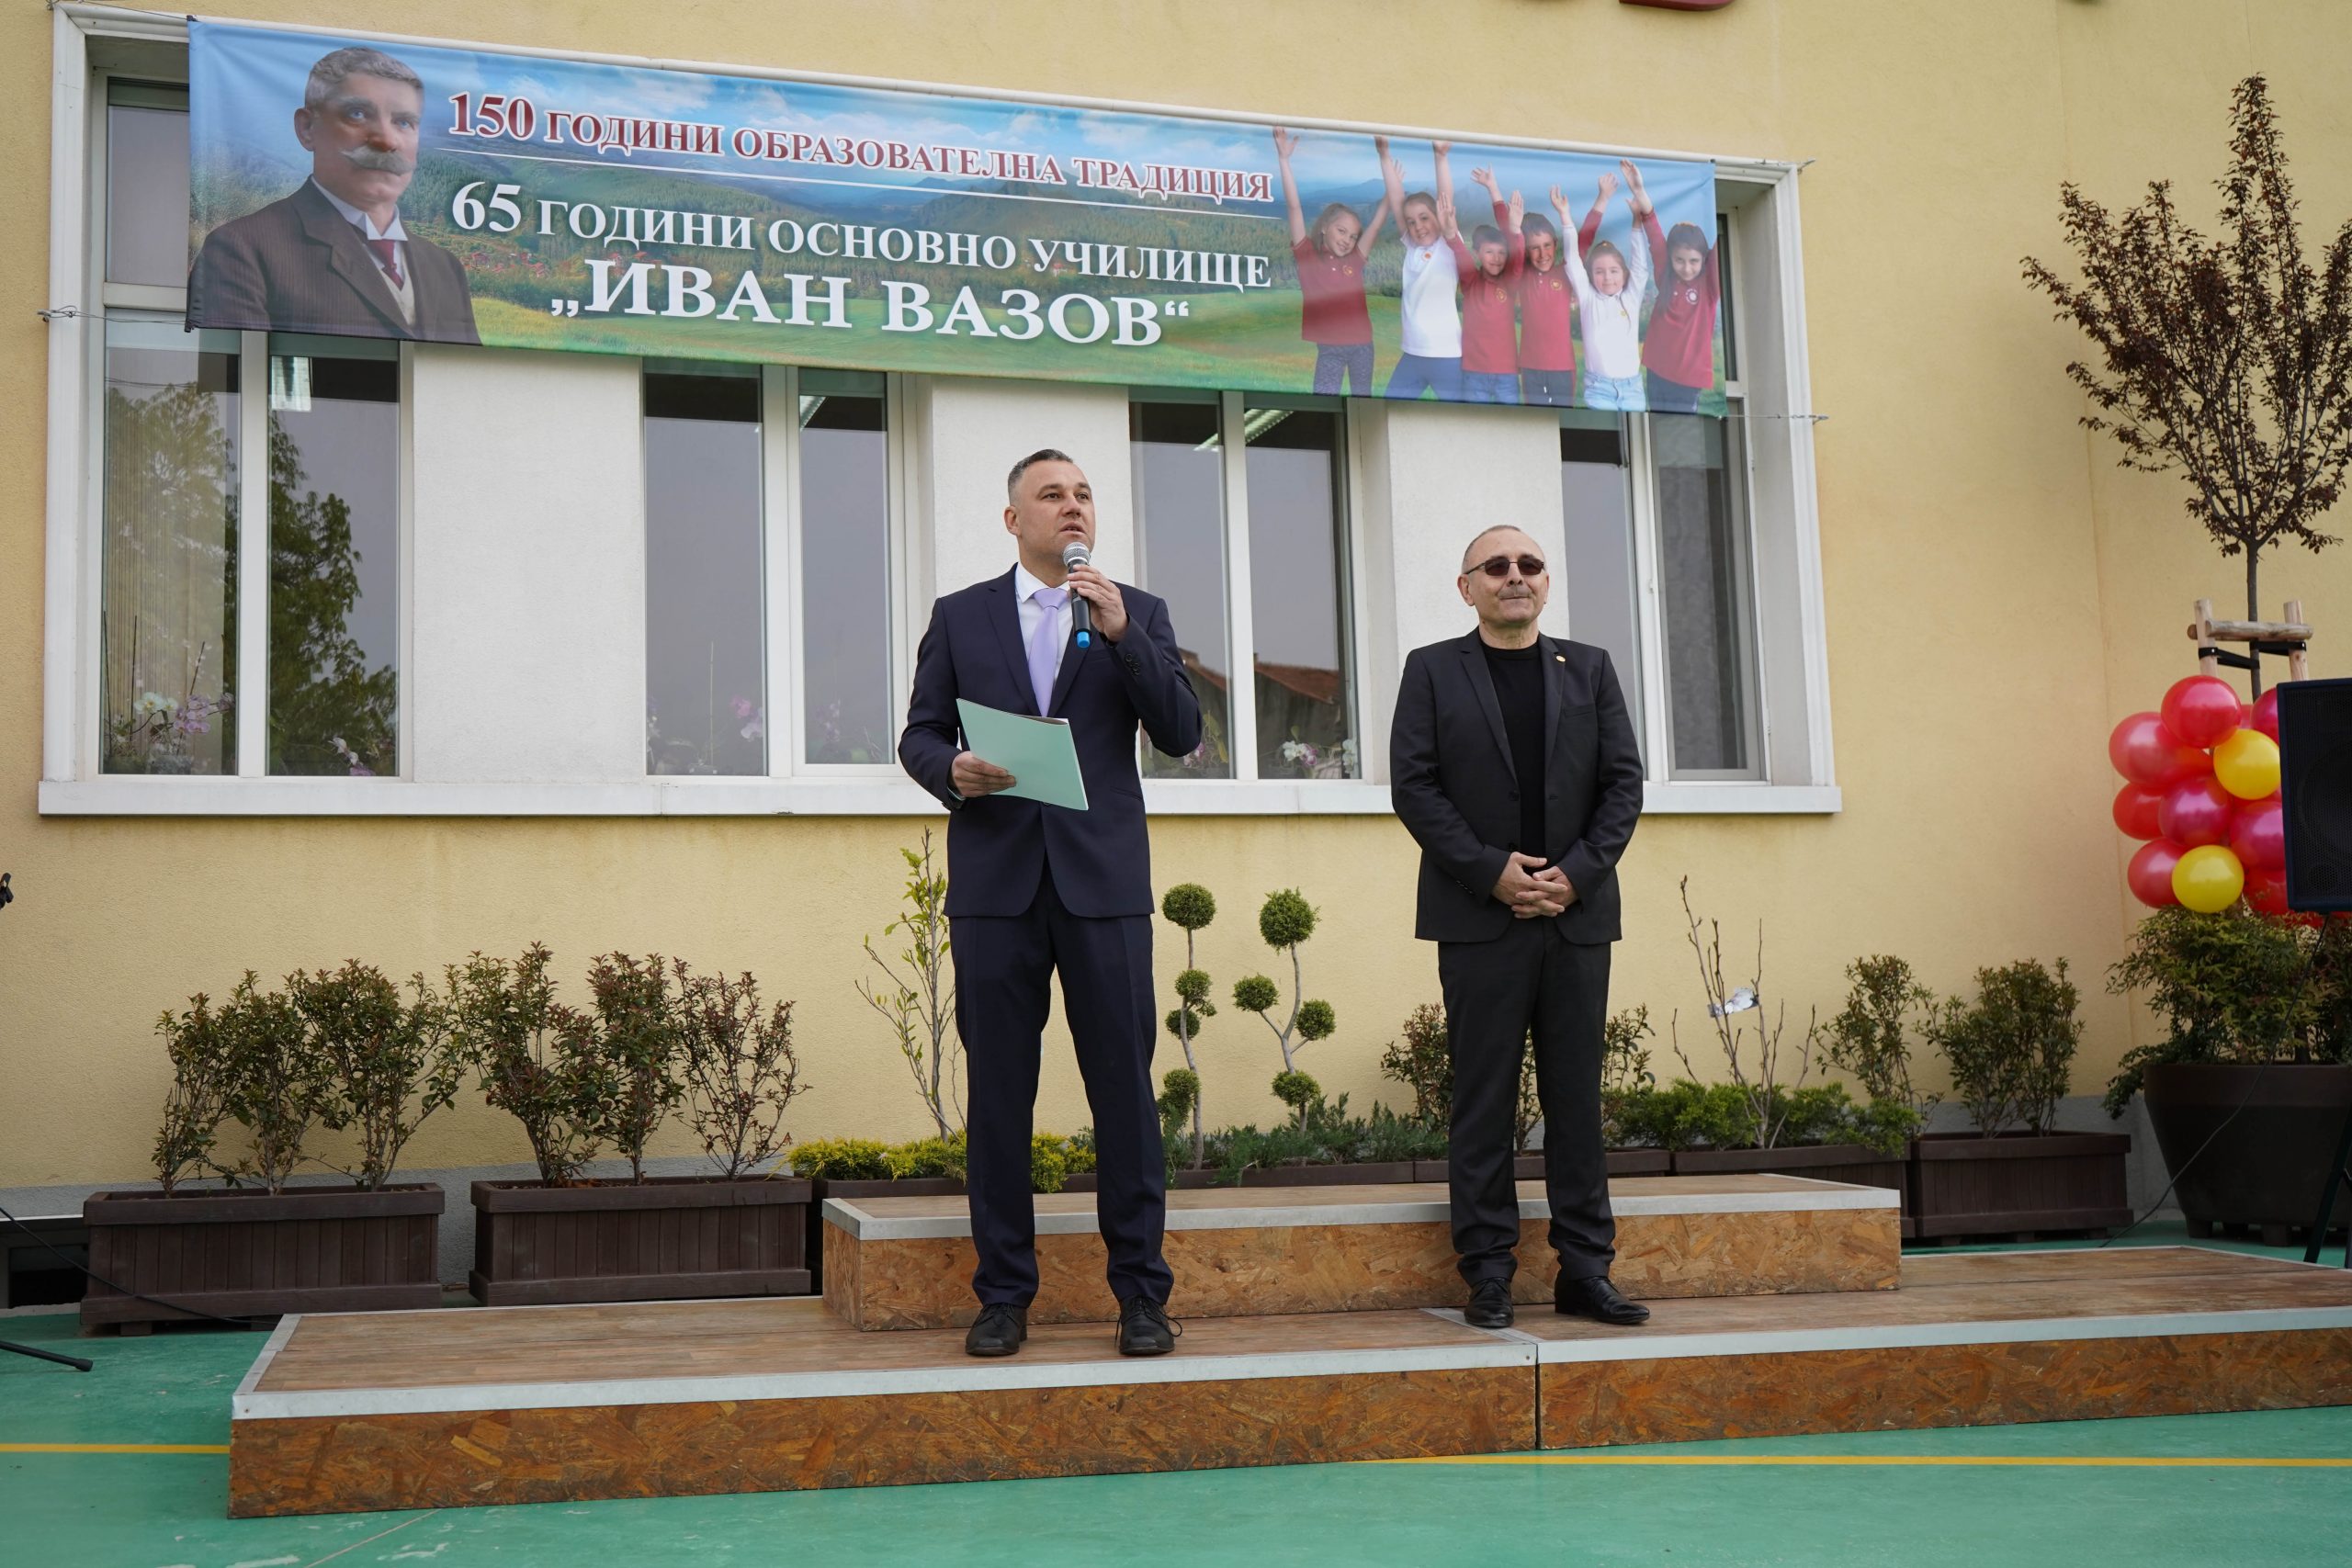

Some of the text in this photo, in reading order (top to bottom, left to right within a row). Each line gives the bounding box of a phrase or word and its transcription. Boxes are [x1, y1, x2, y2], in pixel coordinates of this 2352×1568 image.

[450, 93, 1274, 204] 150 ГОДИНИ ОБРАЗОВАТЕЛНА ТРАДИЦИЯ
[452, 181, 1272, 294] 65 ГОДИНИ ОСНОВНО УЧИЛИЩЕ
[550, 258, 854, 329] „ИВАН
